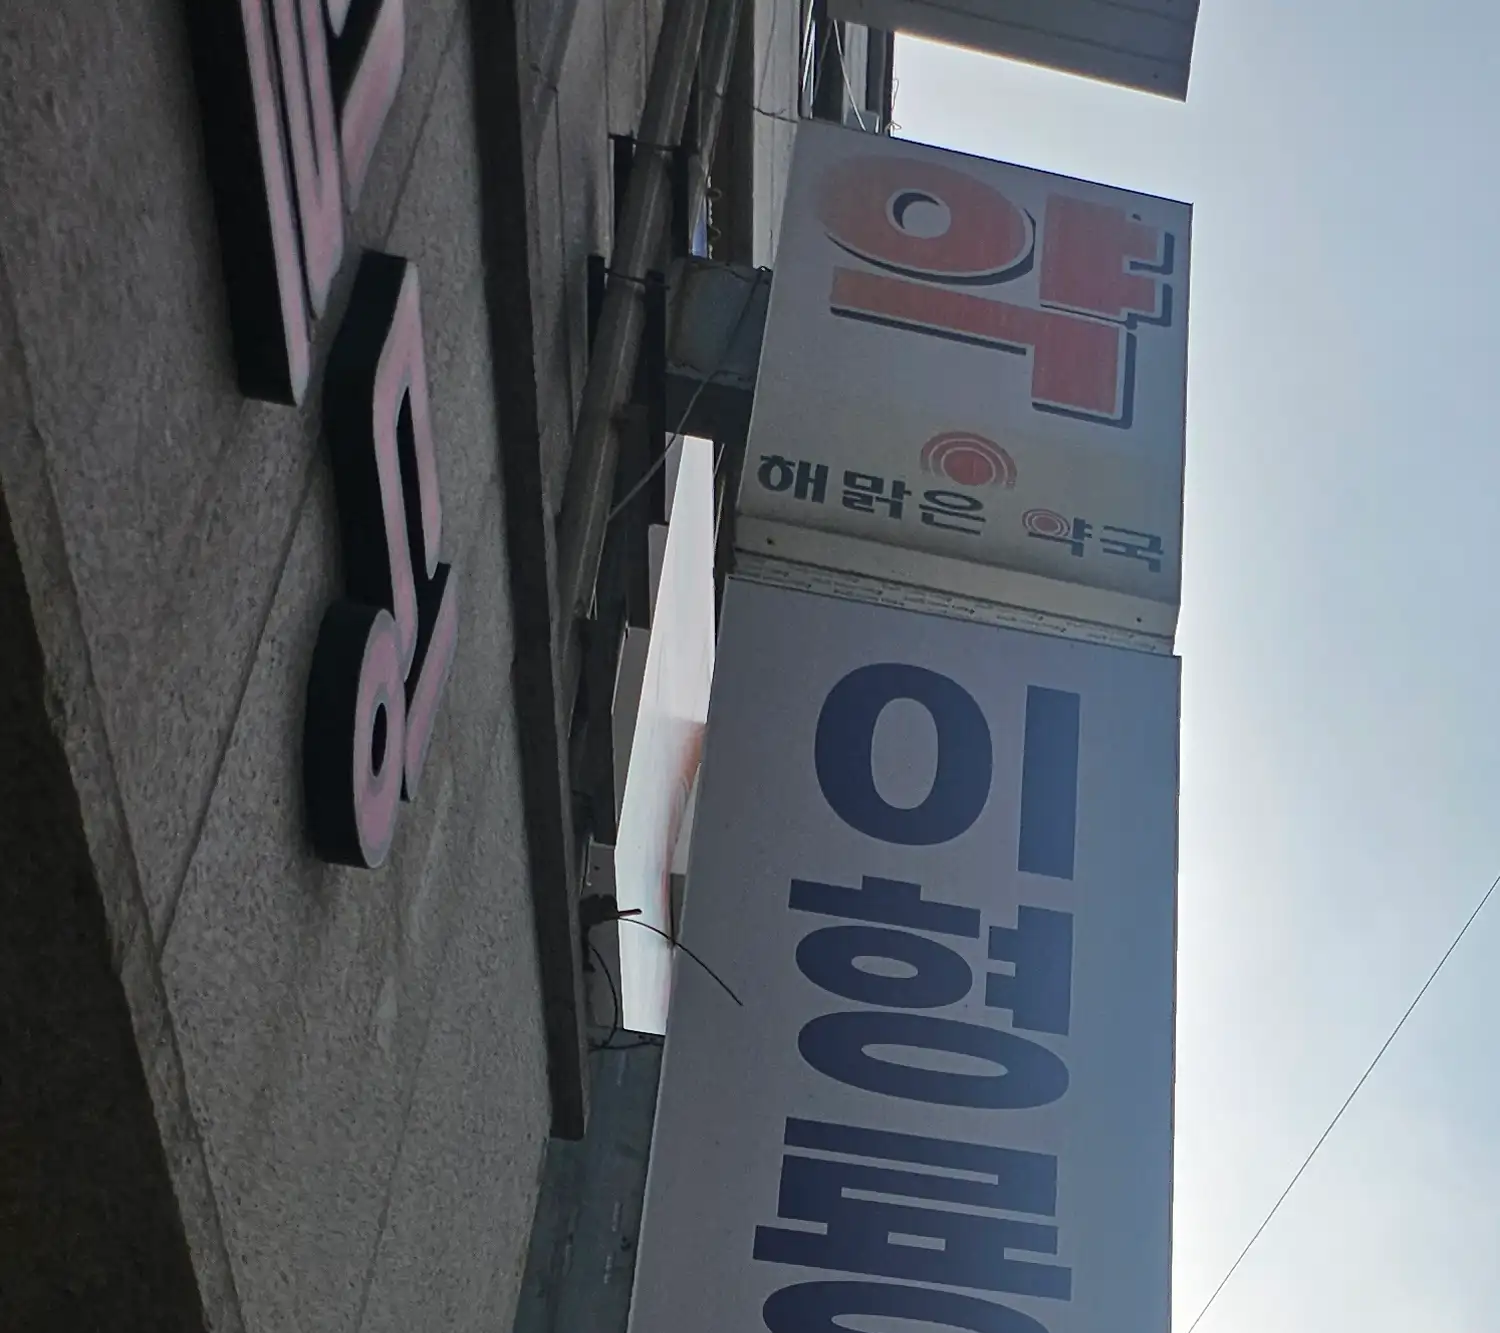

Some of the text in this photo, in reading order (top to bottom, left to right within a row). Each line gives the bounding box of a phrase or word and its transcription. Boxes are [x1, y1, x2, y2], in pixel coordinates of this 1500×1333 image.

[818, 152, 1175, 428] 약
[757, 453, 1164, 573] 해맑은 약국
